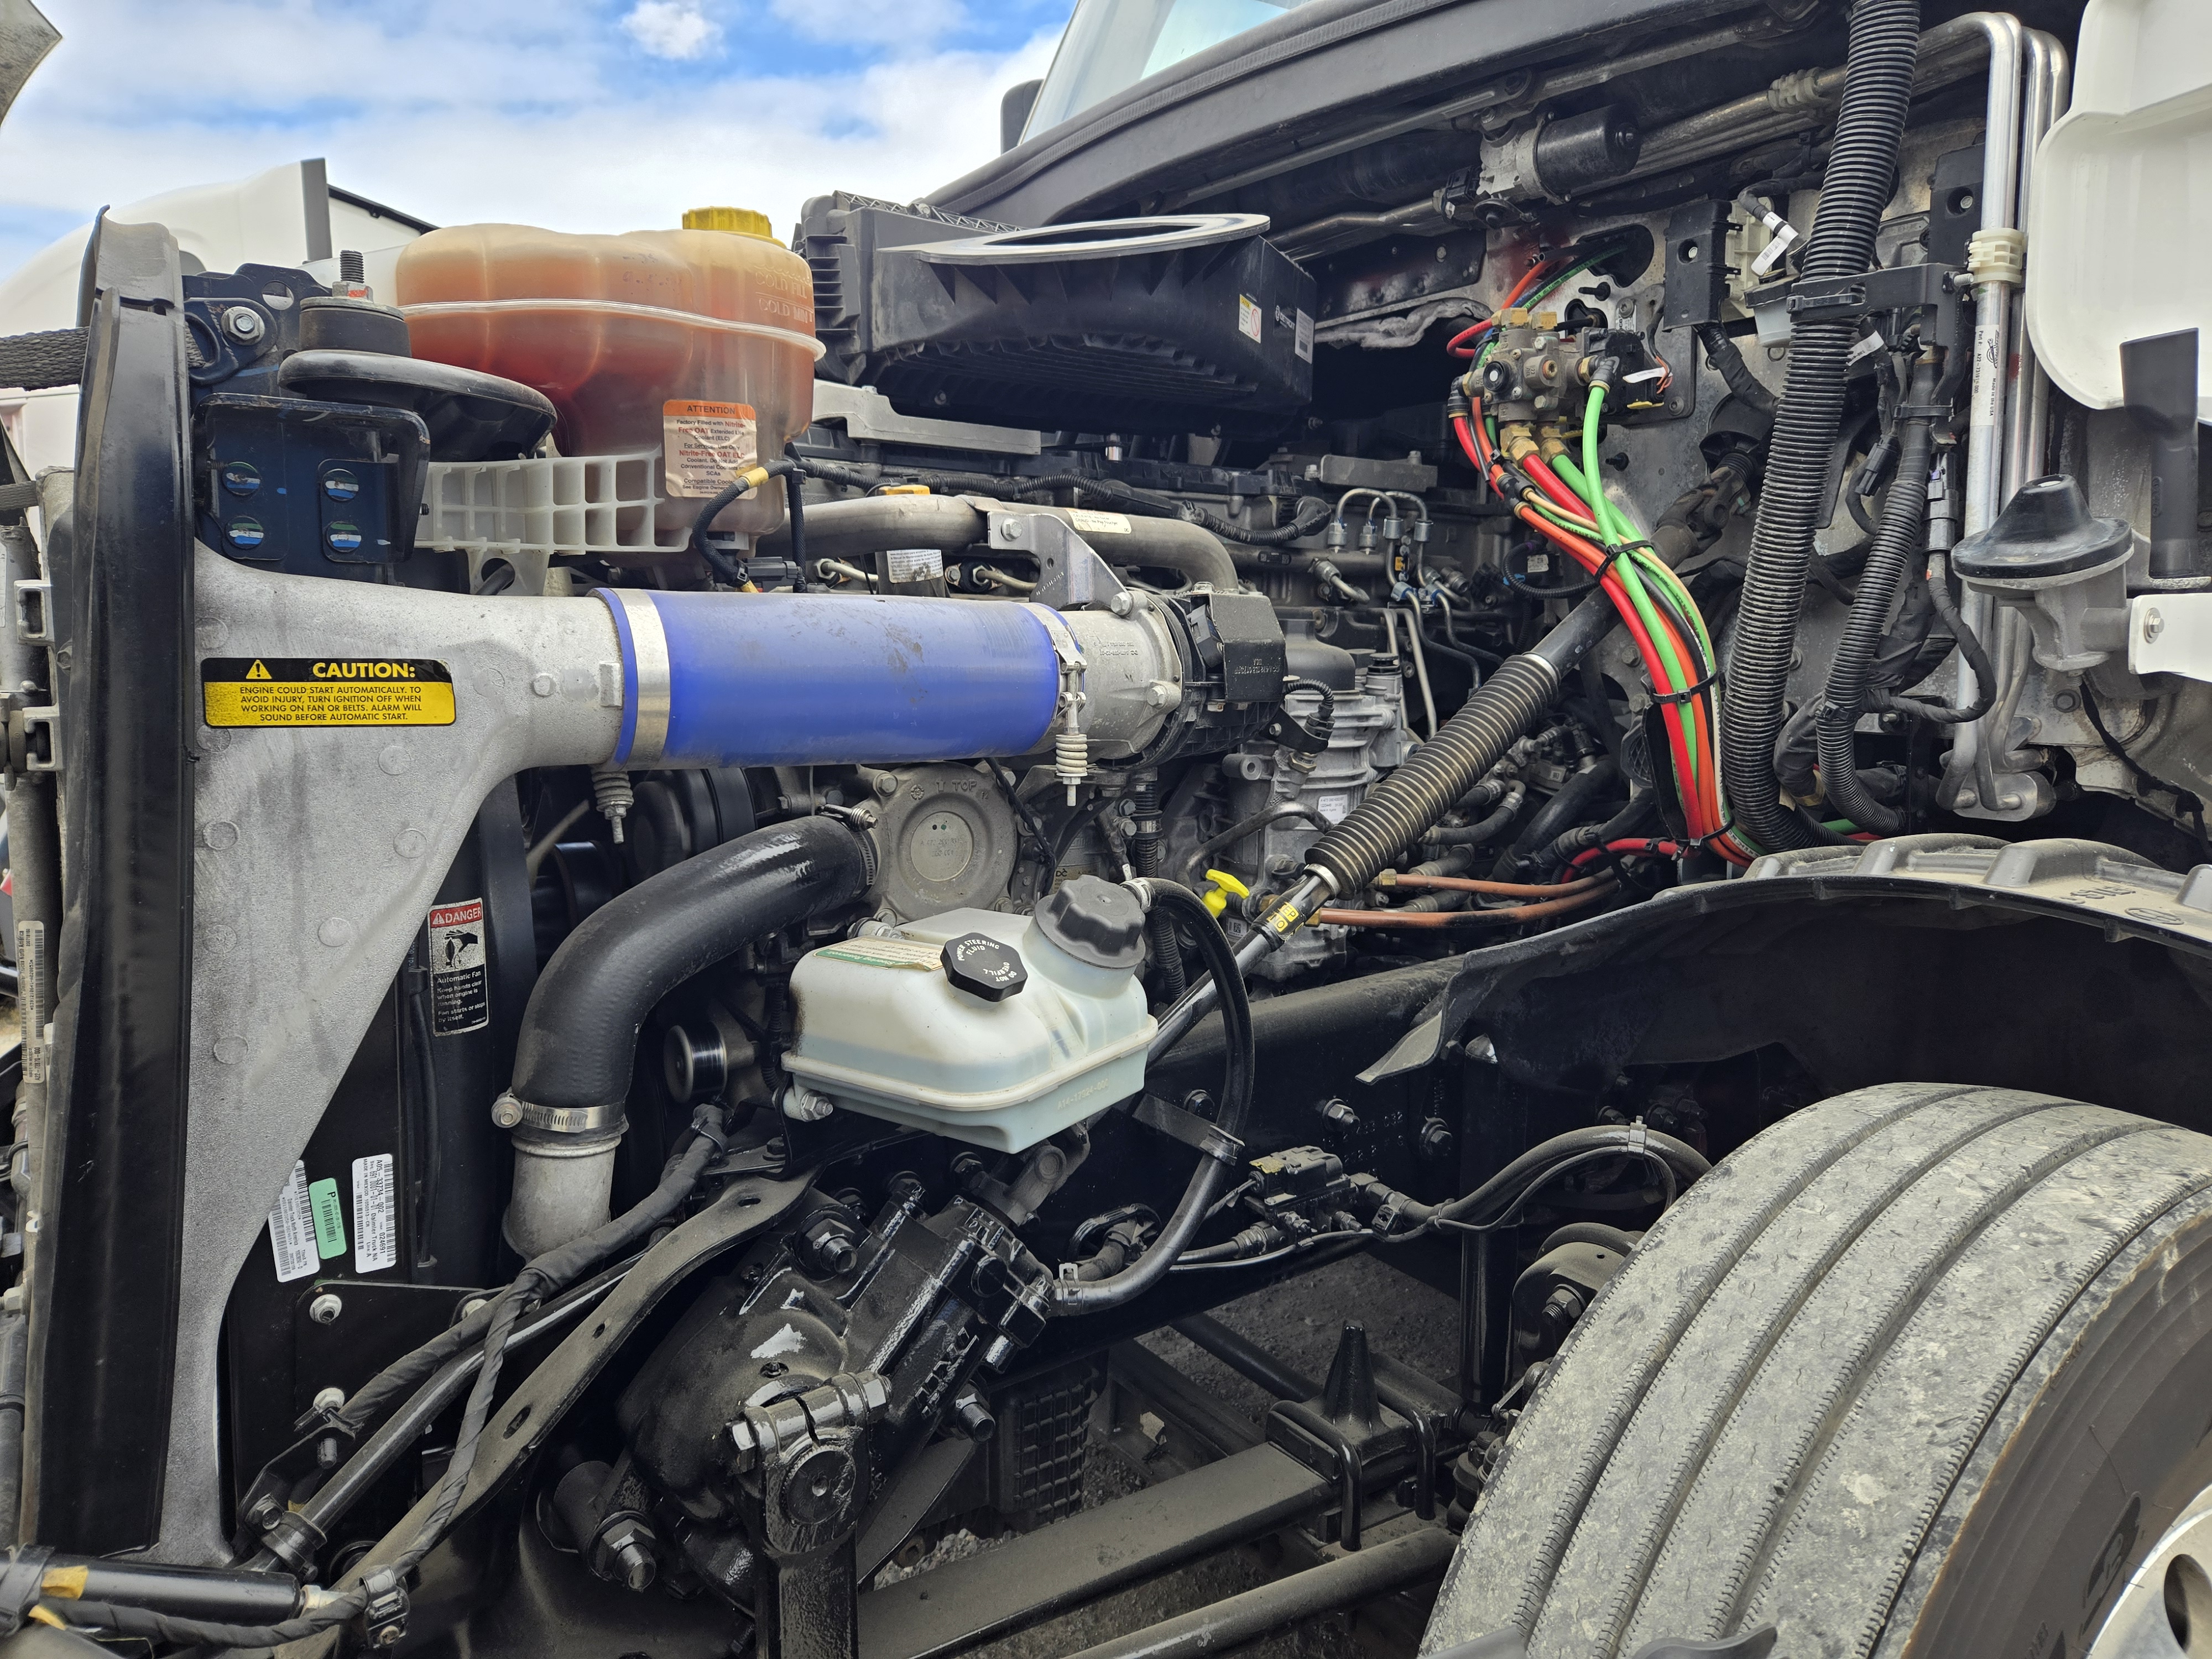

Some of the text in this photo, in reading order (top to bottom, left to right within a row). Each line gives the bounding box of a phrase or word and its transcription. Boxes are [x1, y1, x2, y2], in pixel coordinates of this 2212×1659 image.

[755, 272, 807, 299] COLD FILL
[759, 298, 790, 316] COLD
[1280, 312, 1295, 330] DETROIT
[687, 405, 735, 414] ATTENTION
[312, 662, 415, 679] CAUTION:
[260, 713, 408, 721] SOUND BEFORE AUTOMATIC START.
[952, 779, 977, 791] TOP
[444, 906, 481, 924] DANGER
[956, 940, 1000, 961] POWER STEERING
[966, 945, 985, 956] FLUID
[983, 962, 1010, 976] OVERFILL
[437, 973, 471, 984] Automatic
[455, 989, 473, 998] engine
[474, 1001, 485, 1010] stops
